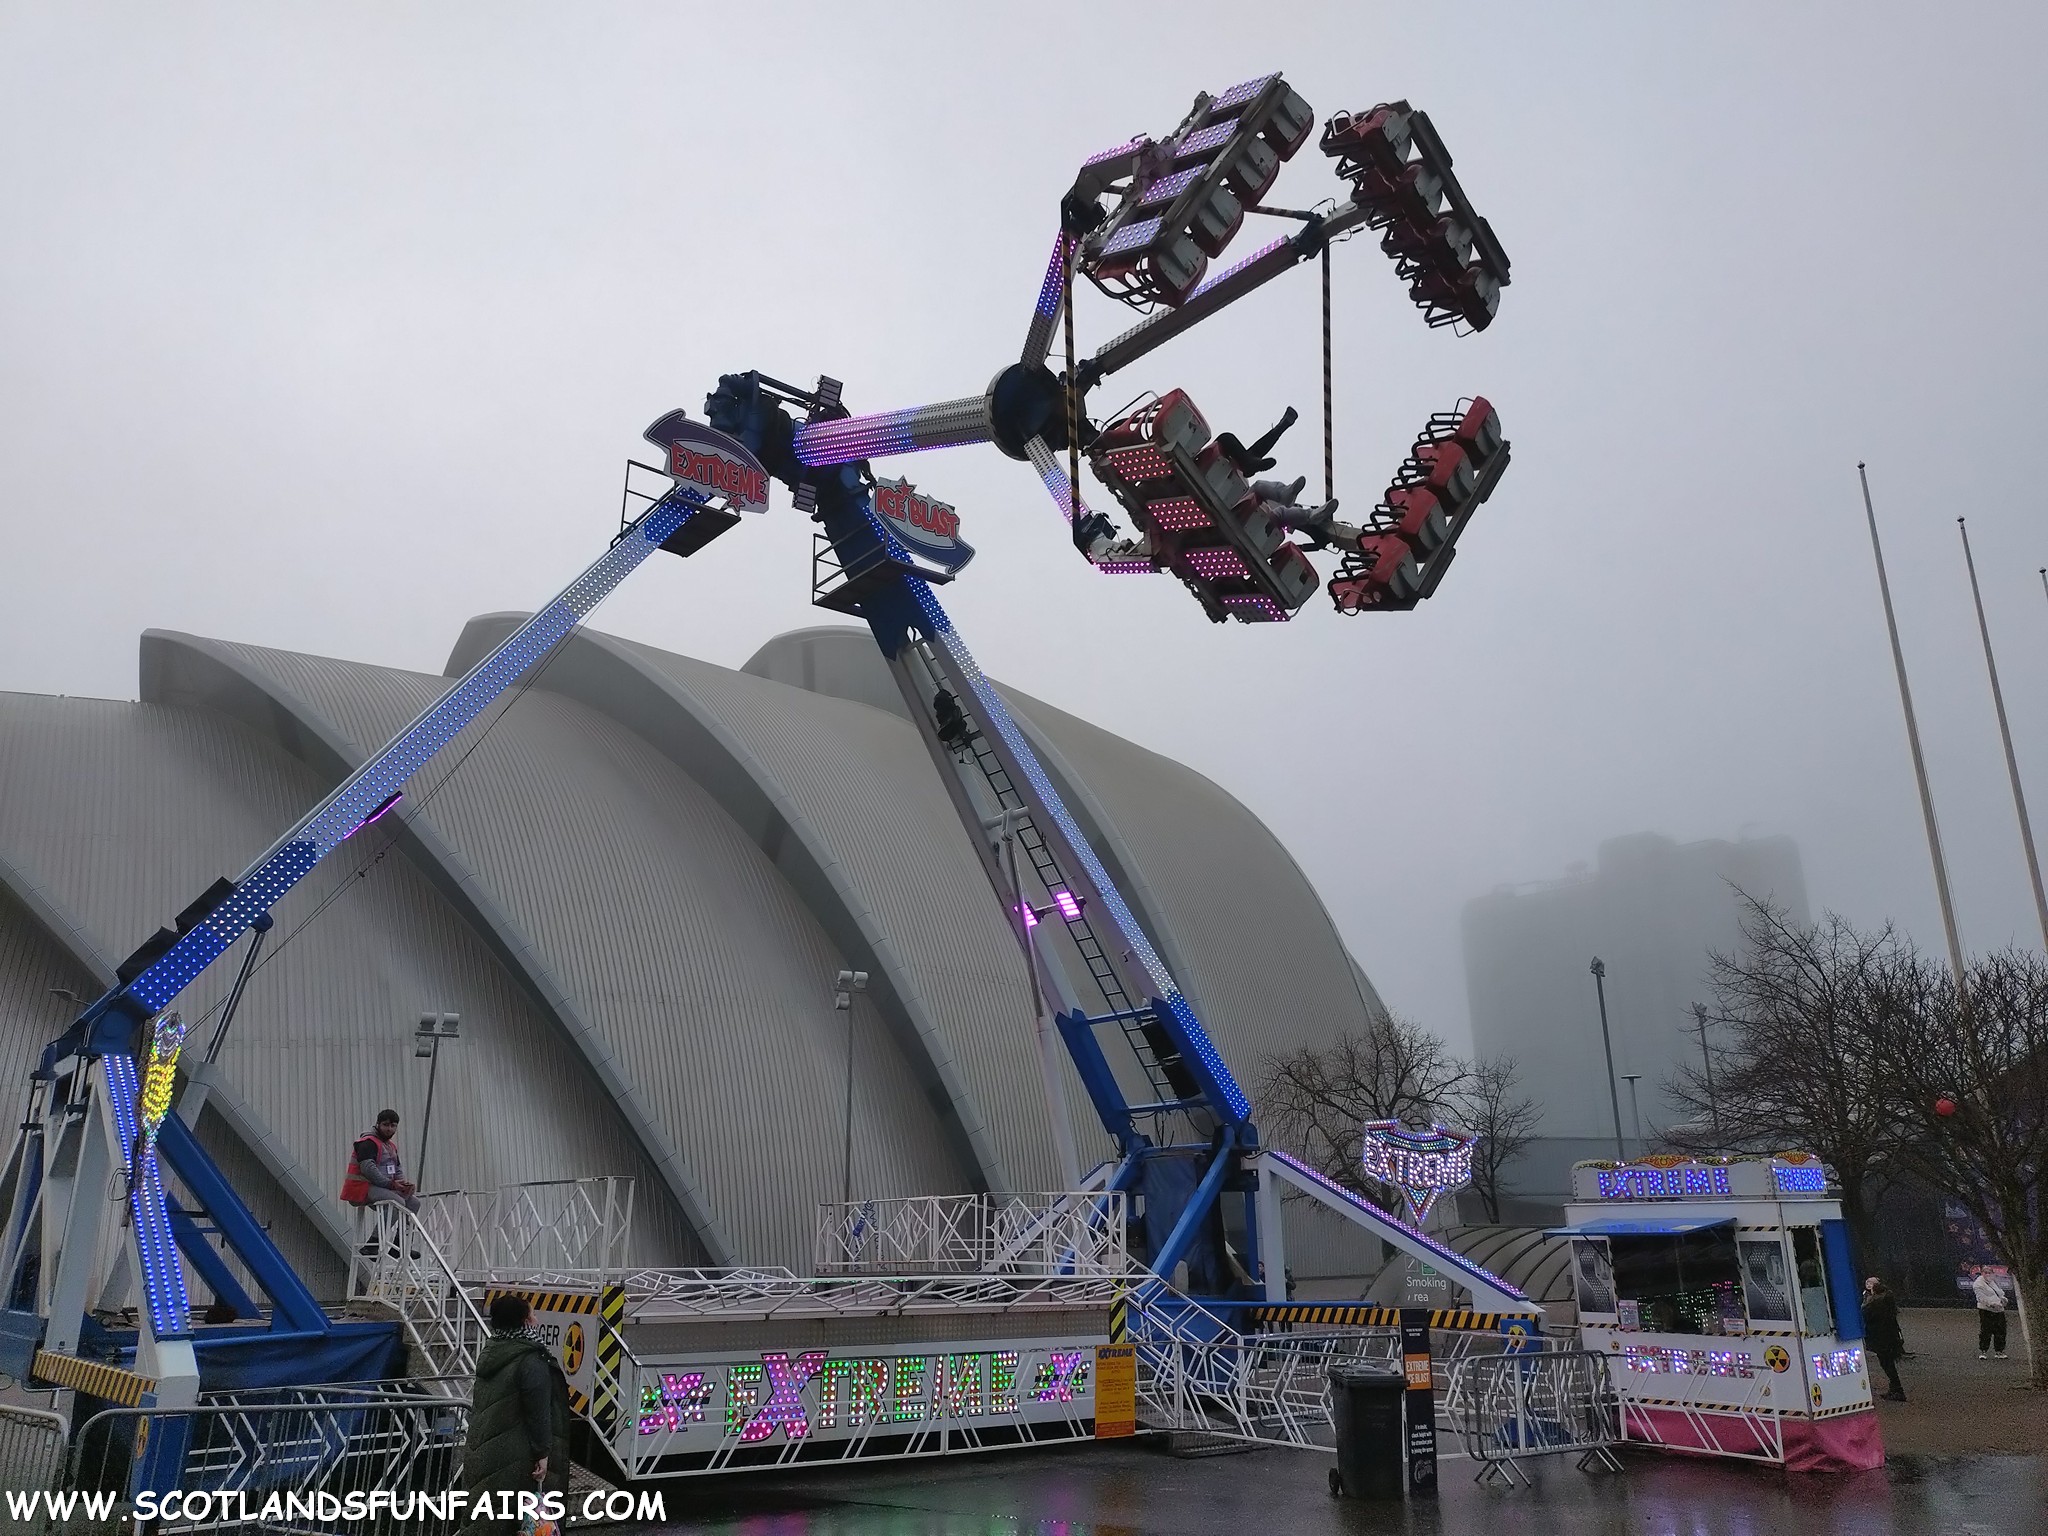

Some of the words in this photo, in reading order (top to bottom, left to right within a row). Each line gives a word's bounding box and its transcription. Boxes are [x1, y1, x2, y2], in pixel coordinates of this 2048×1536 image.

[670, 443, 766, 504] EXTREME
[876, 485, 906, 520] ICE
[908, 499, 959, 539] BLAST
[1364, 1134, 1473, 1189] EXTREME
[1597, 1167, 1732, 1198] EXTREME
[1406, 1276, 1447, 1290] Smoking
[1097, 1347, 1134, 1360] EXTREME
[1406, 1360, 1430, 1372] EXTREME
[1625, 1345, 1755, 1379] EXTREME
[1415, 1373, 1430, 1384] BLAST
[724, 1351, 1020, 1444] EXTREME
